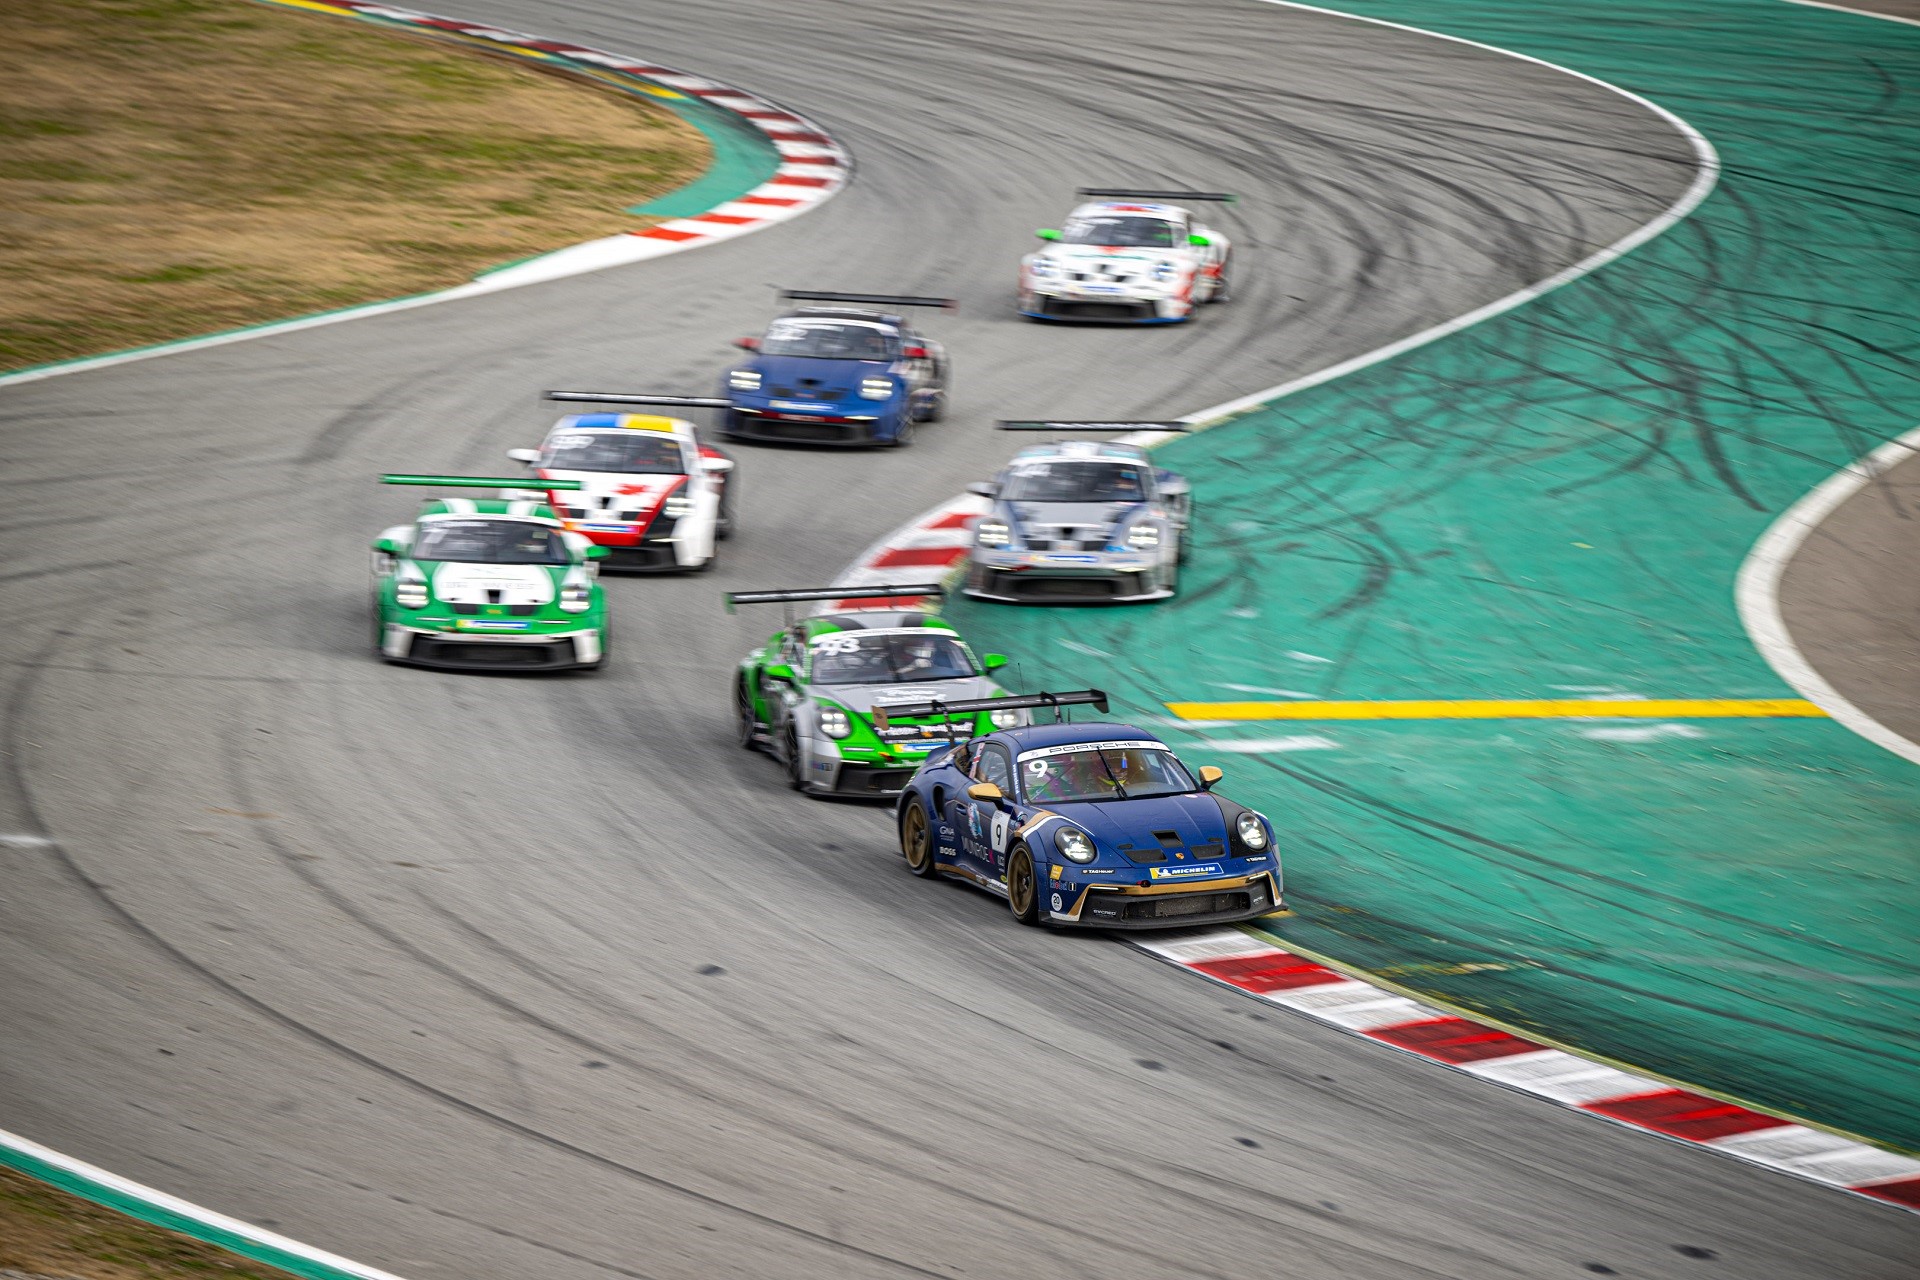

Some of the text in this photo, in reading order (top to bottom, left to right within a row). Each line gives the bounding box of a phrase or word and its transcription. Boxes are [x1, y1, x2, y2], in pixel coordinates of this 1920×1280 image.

[1049, 742, 1141, 753] PORSCHE
[1028, 760, 1048, 778] 9
[995, 824, 1002, 846] 9
[1171, 866, 1216, 875] MICHELIN
